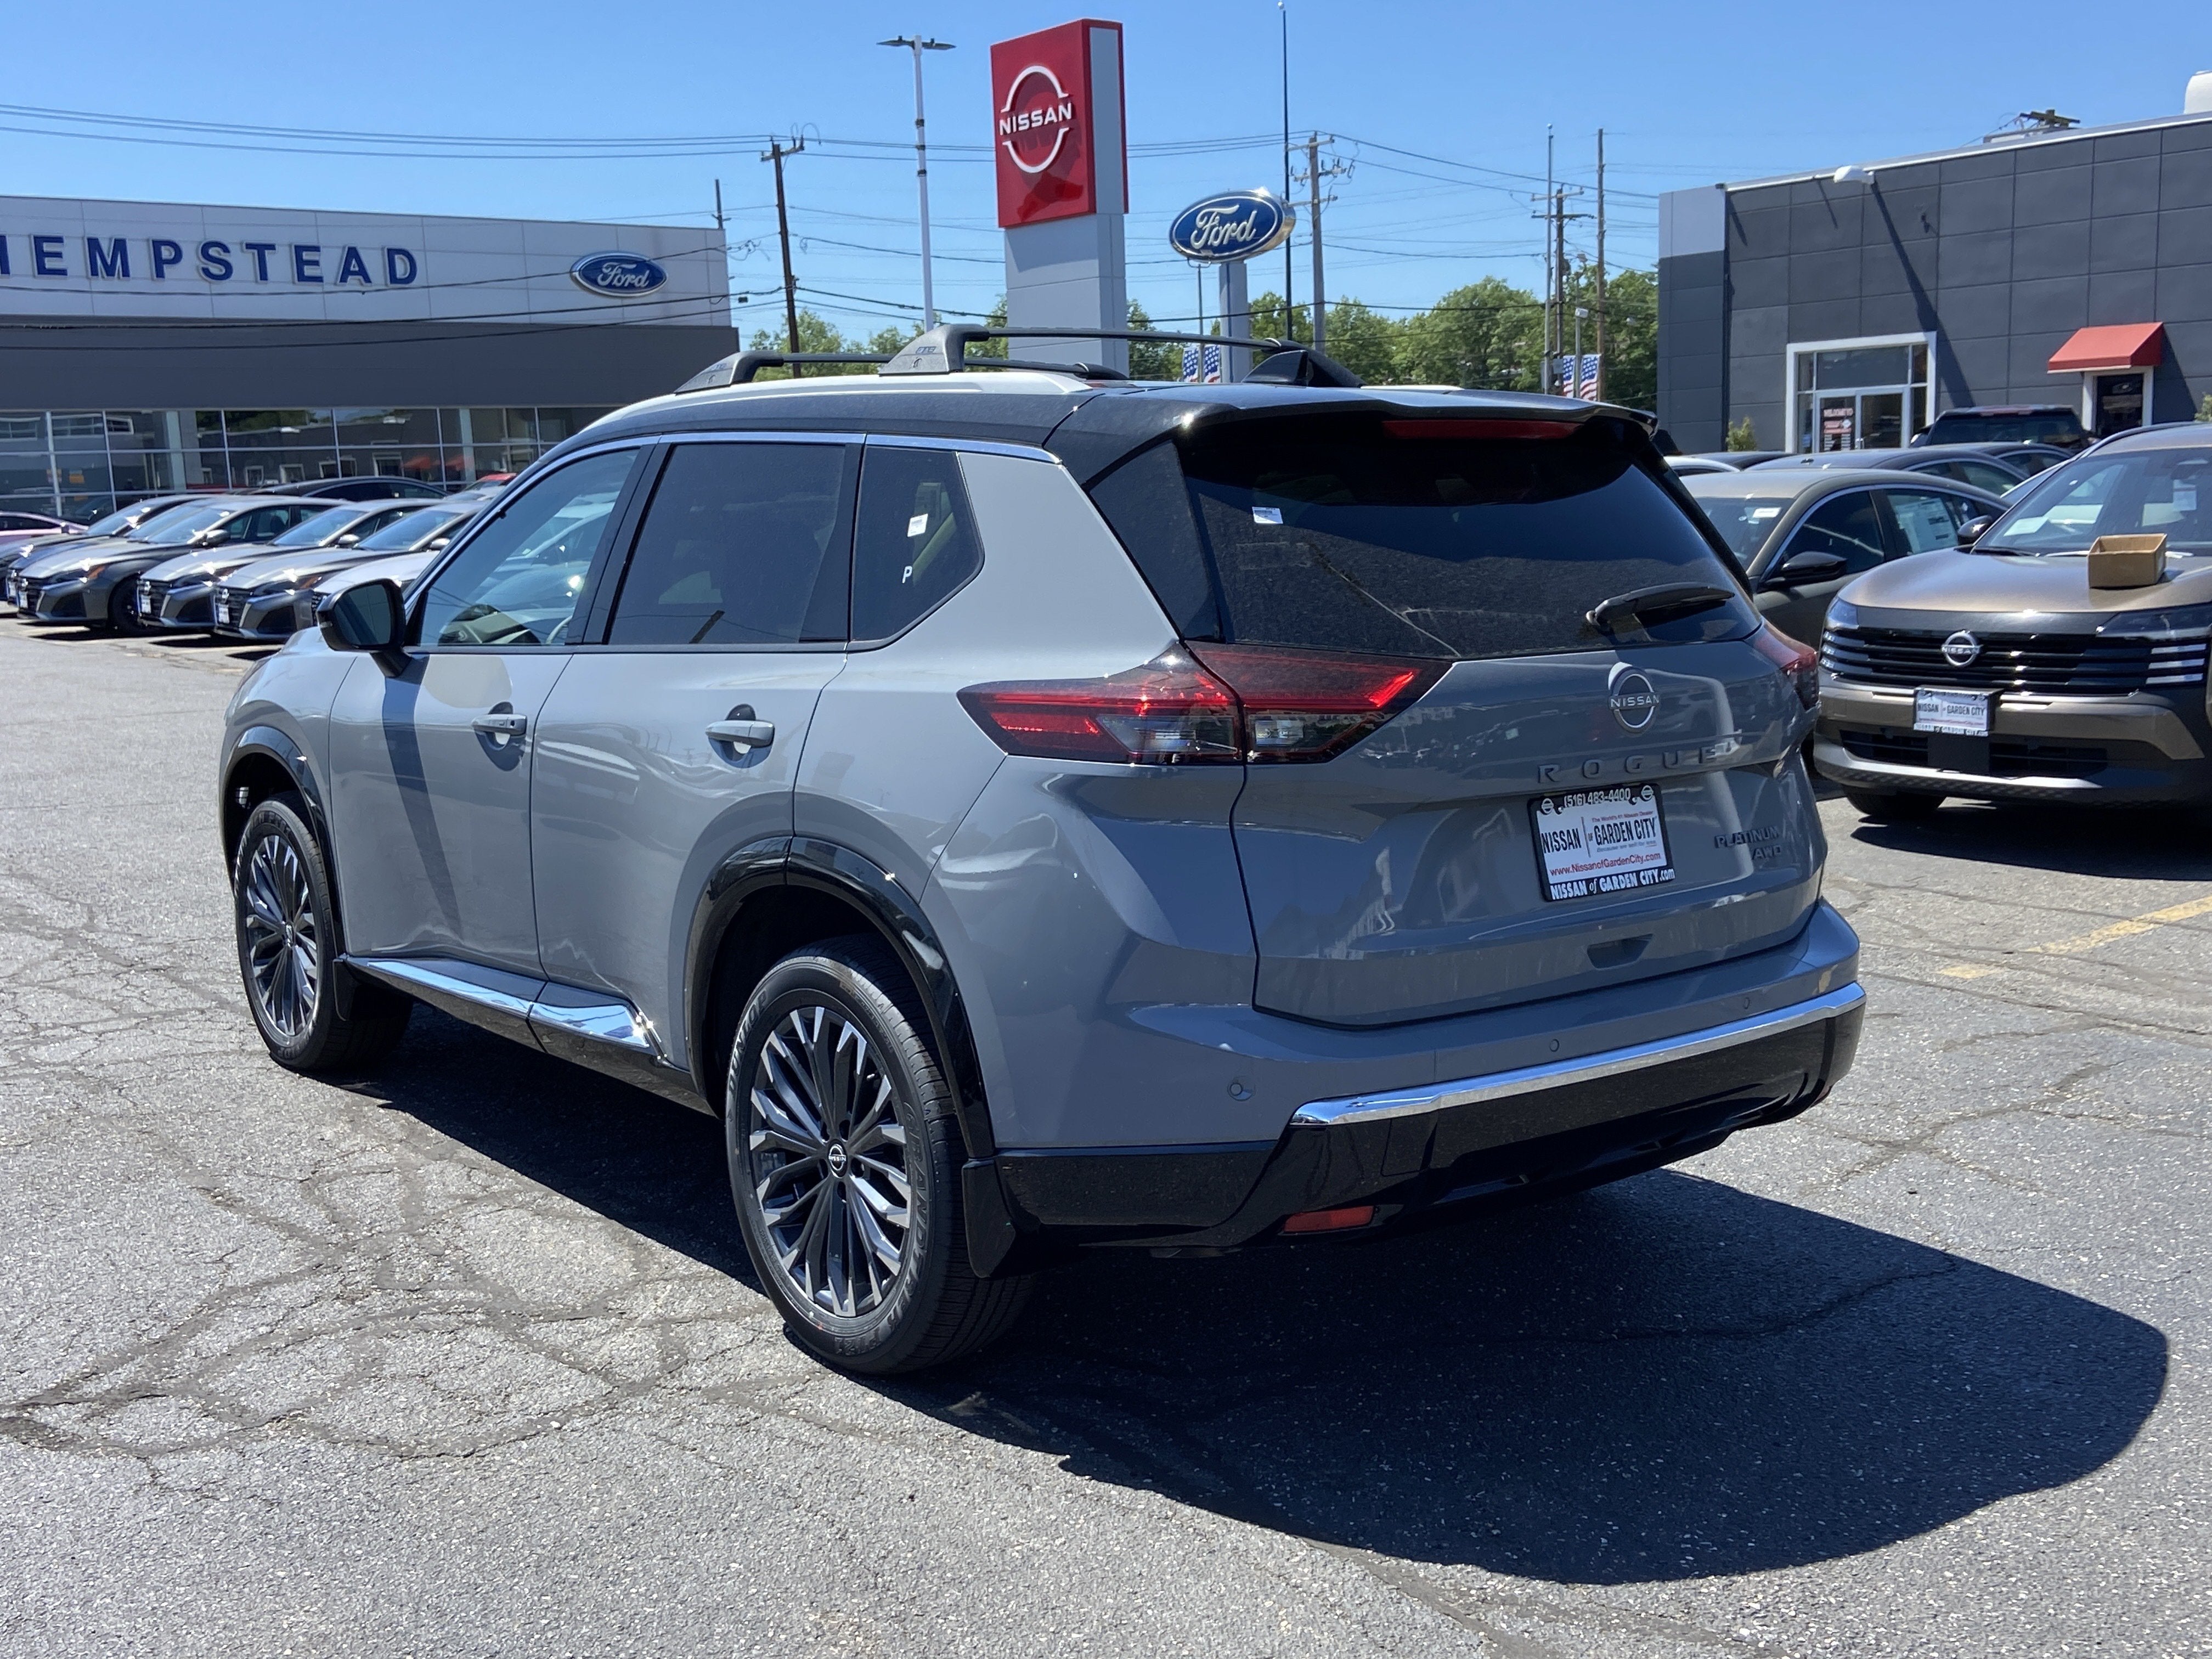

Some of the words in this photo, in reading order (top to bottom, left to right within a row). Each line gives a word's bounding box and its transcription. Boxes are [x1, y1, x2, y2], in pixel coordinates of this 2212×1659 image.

[999, 102, 1072, 136] NISSAN
[1190, 204, 1257, 250] Ford
[597, 262, 650, 287] Ford
[902, 566, 913, 584] P
[1611, 695, 1660, 708] NISSAN
[1917, 703, 1939, 713] NISSAN
[1947, 705, 1970, 715] GARDEN
[1971, 706, 1985, 716] CITY
[1537, 746, 1717, 783] ROGUE
[1564, 793, 1587, 808] (516)
[1587, 788, 1631, 805] 483-4400
[1541, 828, 1582, 854] NISSAN
[1594, 820, 1634, 845] GARDEN
[1634, 817, 1656, 839] CITY
[1714, 825, 1779, 849] PLATINUM
[1550, 853, 1661, 877] www.NissanofGardenCity.com
[1752, 845, 1782, 861] AWD
[1550, 881, 1588, 900] NISSAN
[1589, 878, 1598, 894] of
[1599, 872, 1638, 892] GARDEN
[729, 989, 768, 1093] DUNLOP
